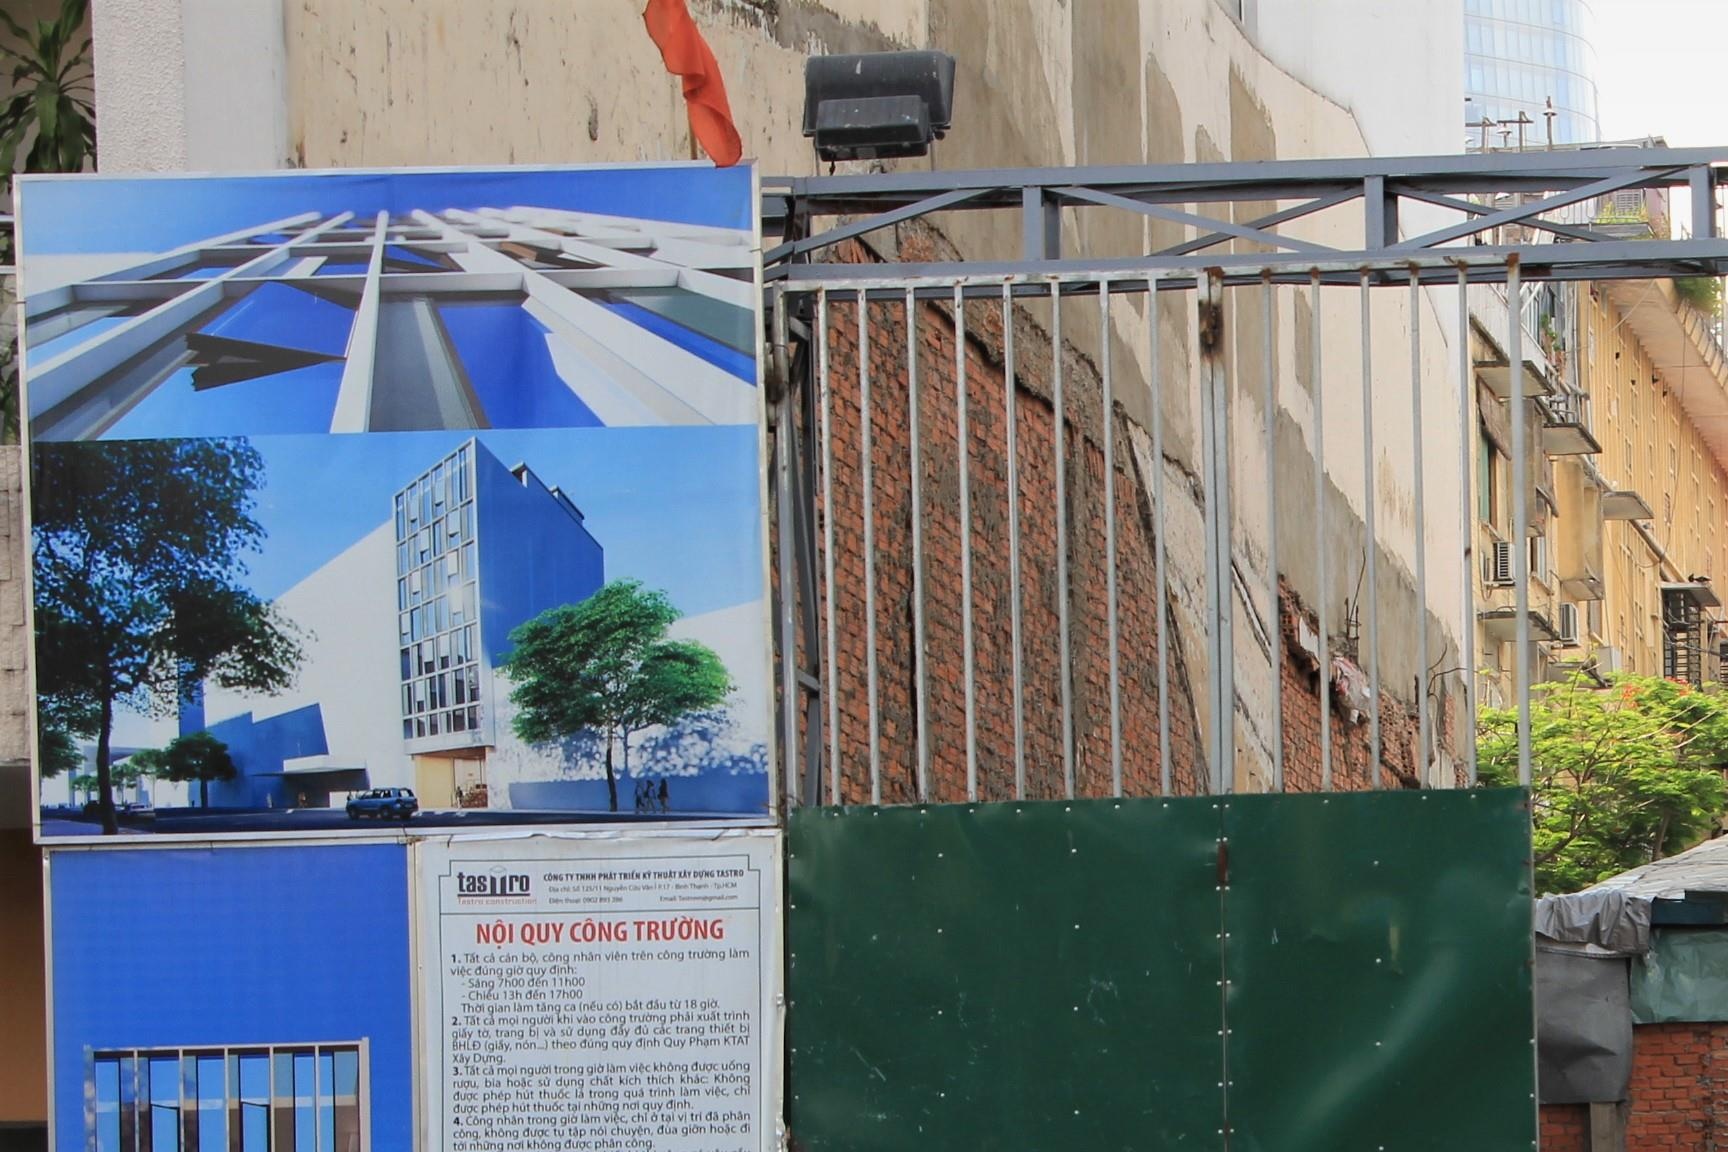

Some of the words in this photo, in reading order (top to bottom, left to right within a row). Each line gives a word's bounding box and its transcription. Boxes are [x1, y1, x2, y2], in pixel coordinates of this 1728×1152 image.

[476, 919, 513, 949] NỘI
[520, 922, 564, 946] QUY
[570, 917, 627, 942] CÔNG
[633, 915, 723, 942] TRƯỜNG
